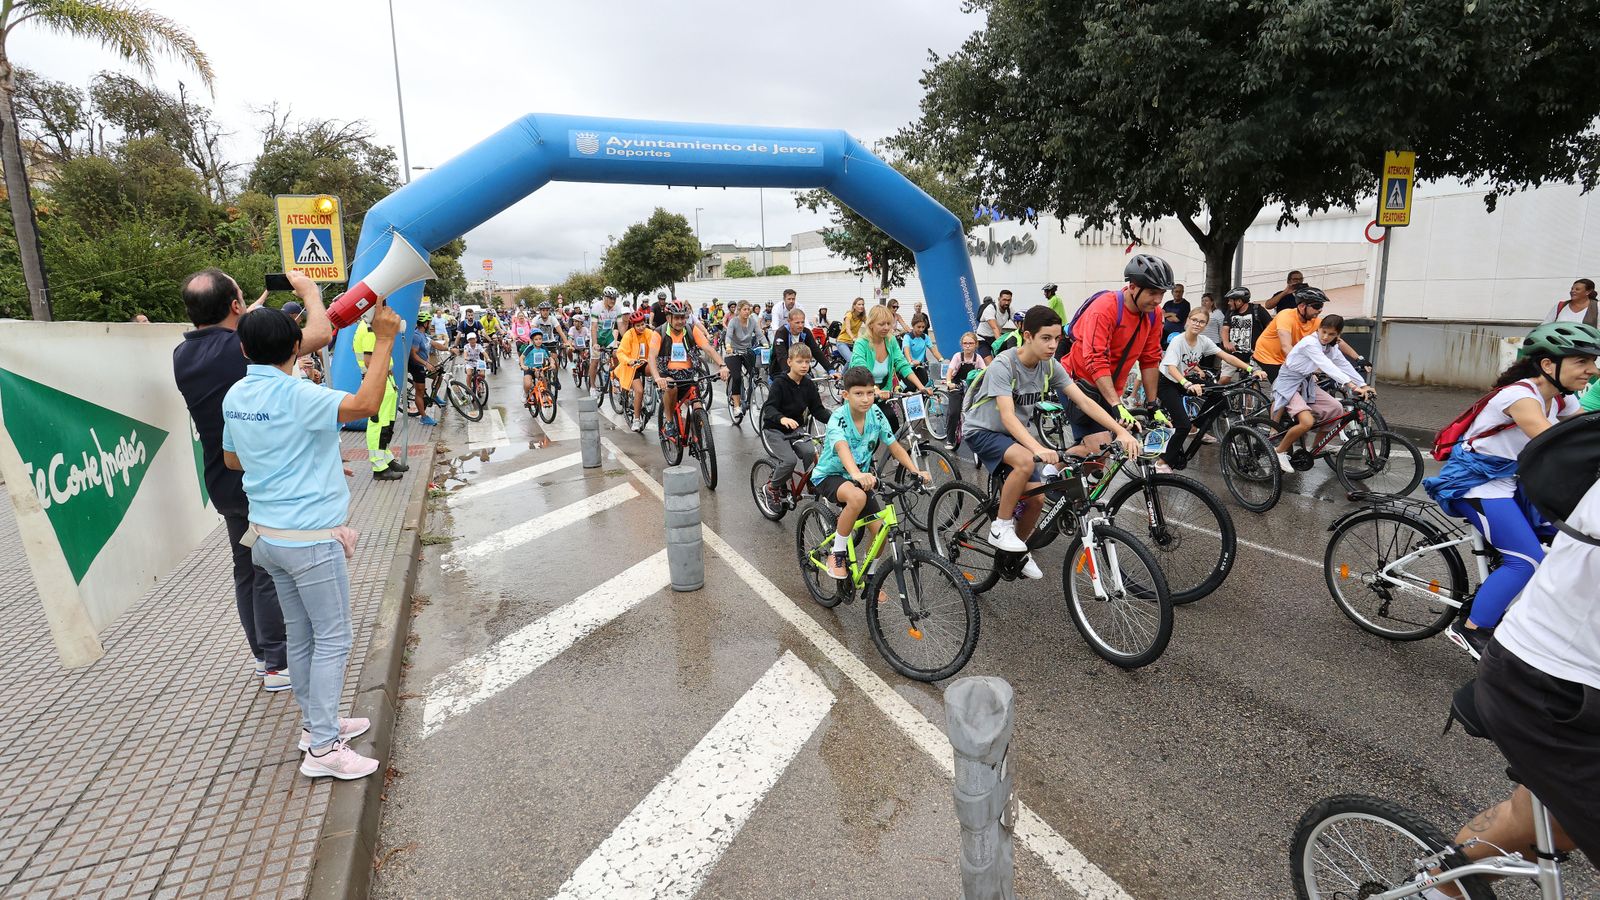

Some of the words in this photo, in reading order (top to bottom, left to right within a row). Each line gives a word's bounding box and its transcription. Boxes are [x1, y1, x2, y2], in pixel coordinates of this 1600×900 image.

[605, 147, 671, 158] Deportes
[606, 135, 743, 152] Ayuntamiento
[746, 143, 768, 153] de
[772, 143, 817, 155] Jerez
[1382, 212, 1406, 222] PEATONES
[49, 452, 102, 504] Corte
[89, 427, 146, 498] Inglés
[1039, 495, 1067, 531] ROCKRIDER
